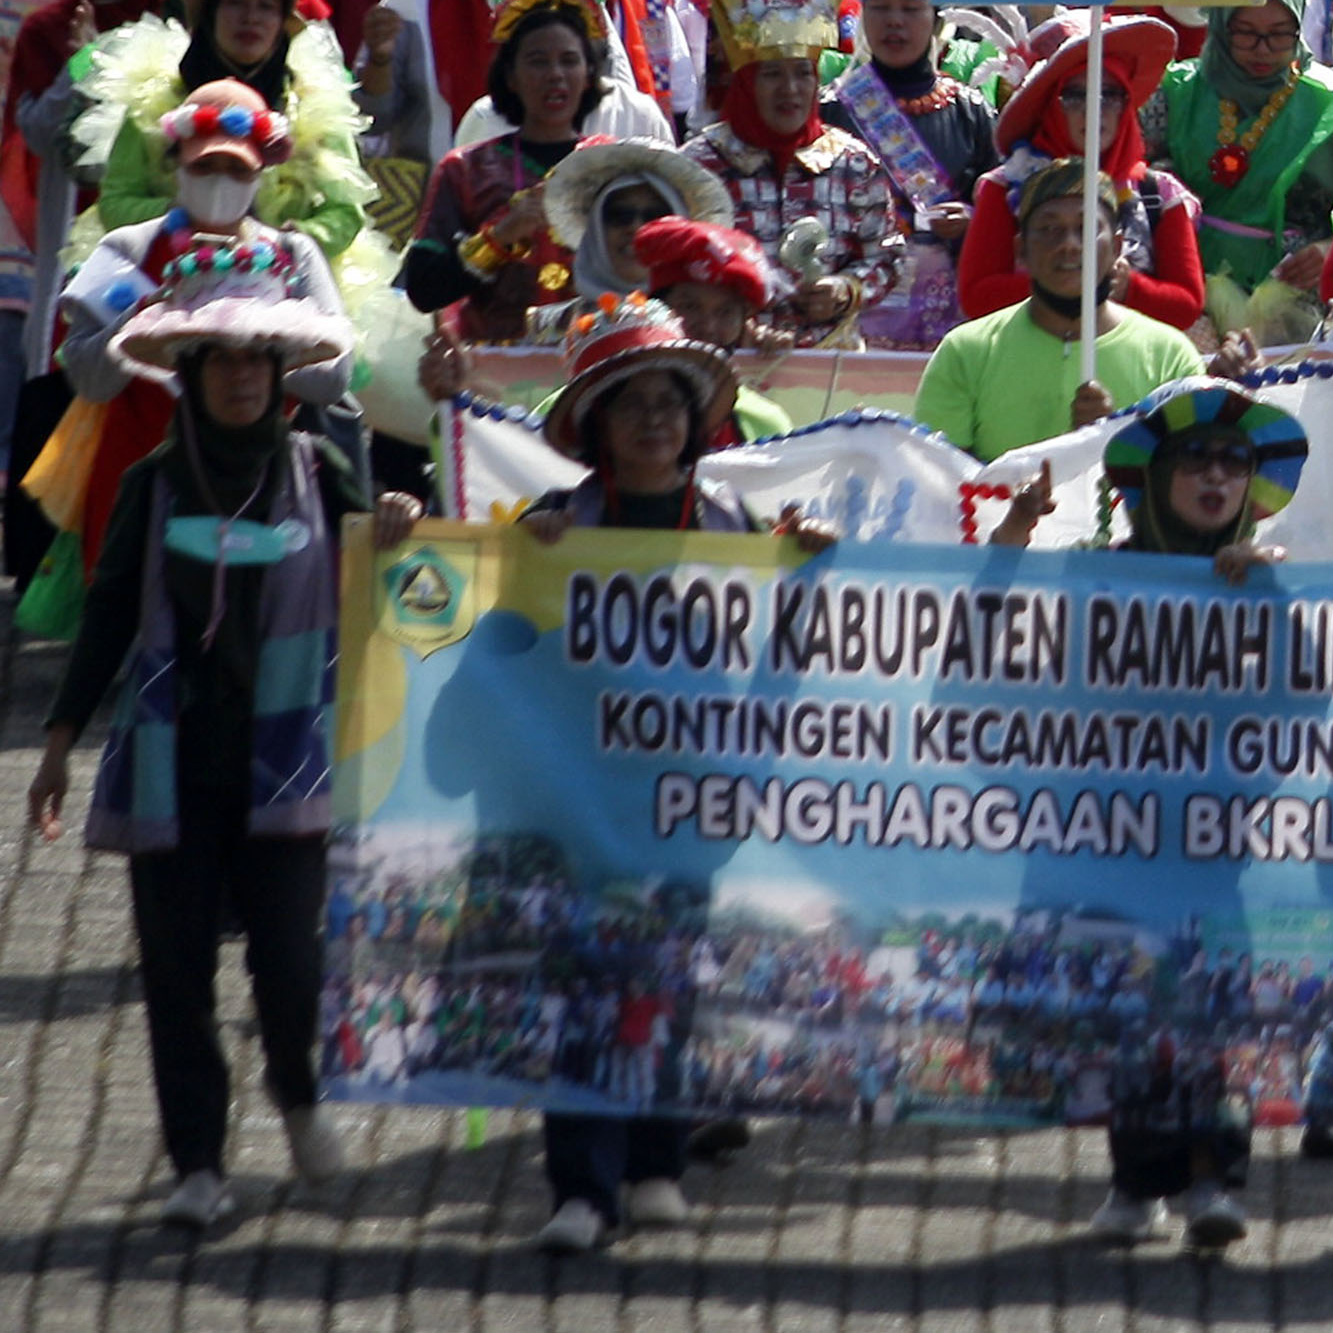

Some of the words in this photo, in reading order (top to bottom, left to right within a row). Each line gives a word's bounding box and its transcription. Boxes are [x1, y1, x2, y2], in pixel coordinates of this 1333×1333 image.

[568, 571, 752, 670] BOGOR
[772, 579, 1067, 685] KABUPATEN
[1088, 595, 1269, 692] RAMAH
[601, 692, 892, 762] KONTINGEN
[914, 704, 1208, 770] KECAMATAN
[655, 772, 1160, 857] PENGHARGAAN
